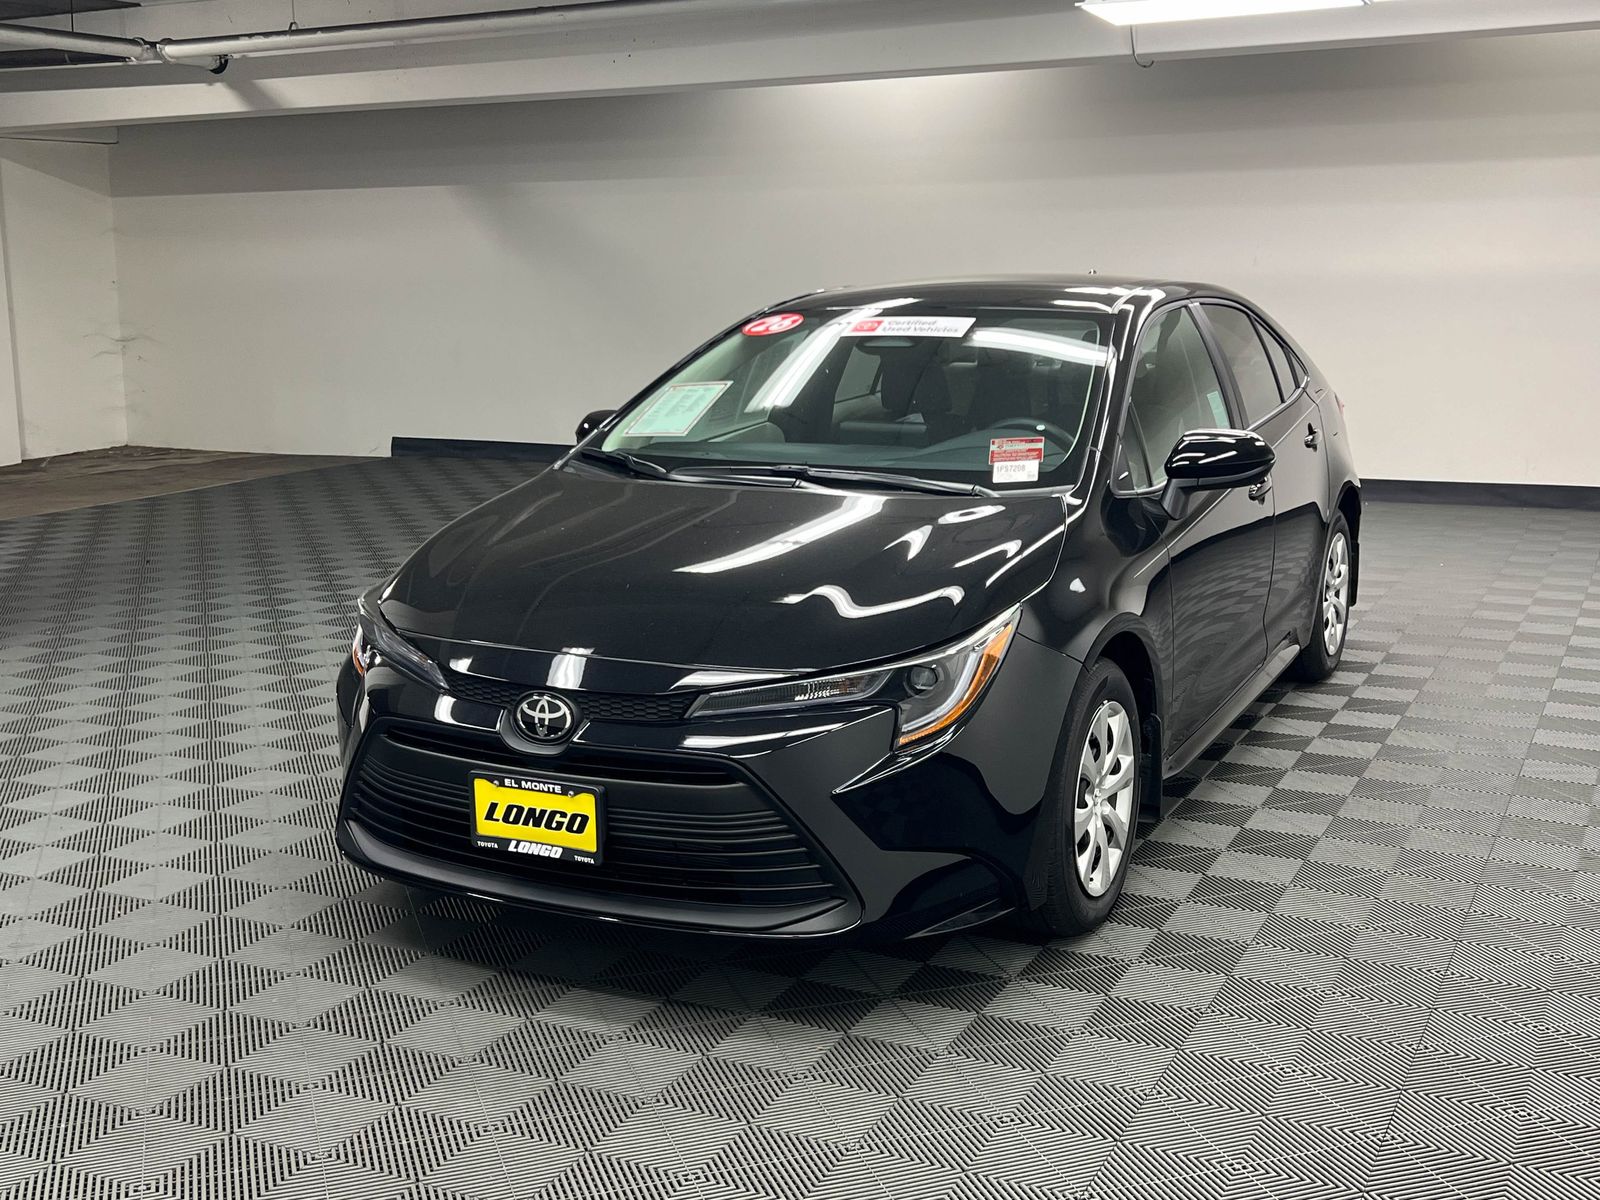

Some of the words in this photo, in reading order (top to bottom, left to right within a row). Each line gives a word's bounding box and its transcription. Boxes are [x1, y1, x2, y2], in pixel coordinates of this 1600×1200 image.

[504, 778, 518, 788] EL
[521, 780, 562, 793] MONTE
[484, 801, 590, 835] LONGO
[476, 841, 498, 849] TOYOTA
[507, 840, 563, 859] LONGO
[573, 855, 595, 864] TOYOTA
